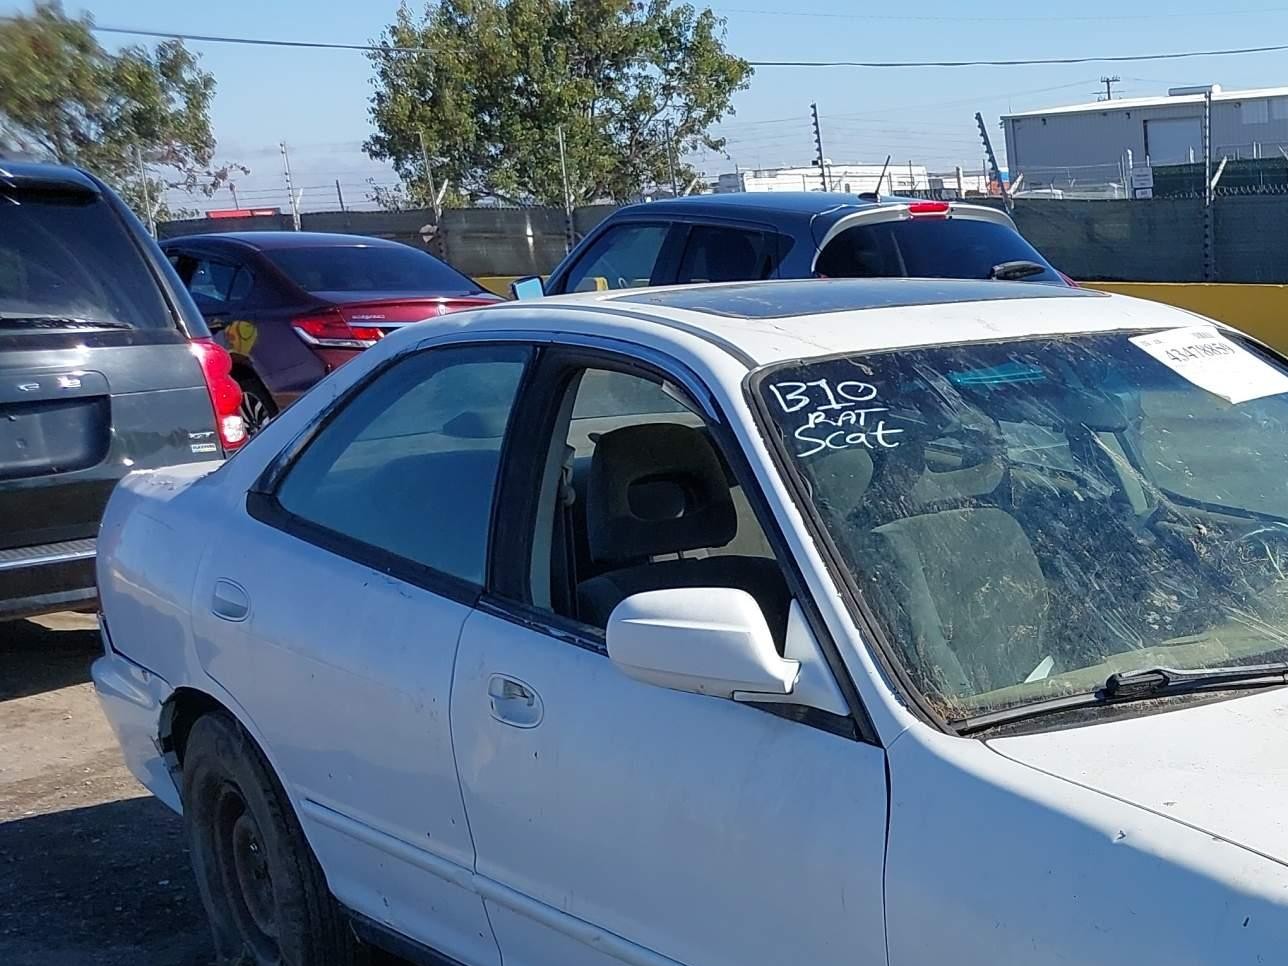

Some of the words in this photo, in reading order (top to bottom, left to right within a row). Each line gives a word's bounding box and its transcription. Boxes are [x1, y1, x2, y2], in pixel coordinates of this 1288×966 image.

[1164, 342, 1236, 363] 43478859
[808, 408, 889, 429] RAT
[794, 420, 904, 458] Scat
